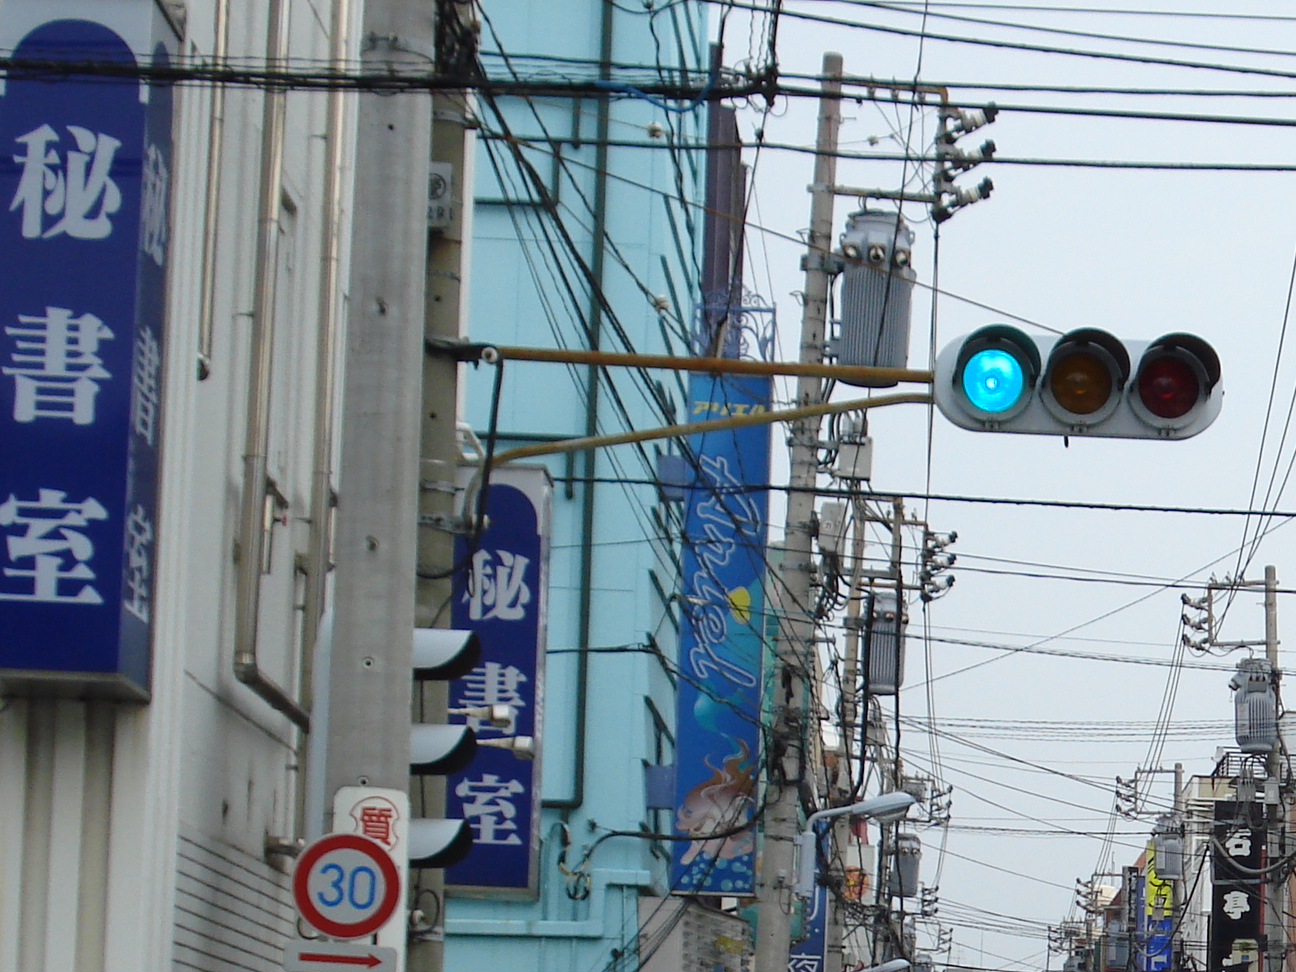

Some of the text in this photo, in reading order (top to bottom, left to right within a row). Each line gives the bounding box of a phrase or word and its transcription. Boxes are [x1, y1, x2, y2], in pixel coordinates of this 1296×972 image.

[0, 122, 122, 607] 秘書室
[455, 549, 531, 848] 秘書室
[317, 863, 377, 910] 30
[361, 806, 393, 846] 質
